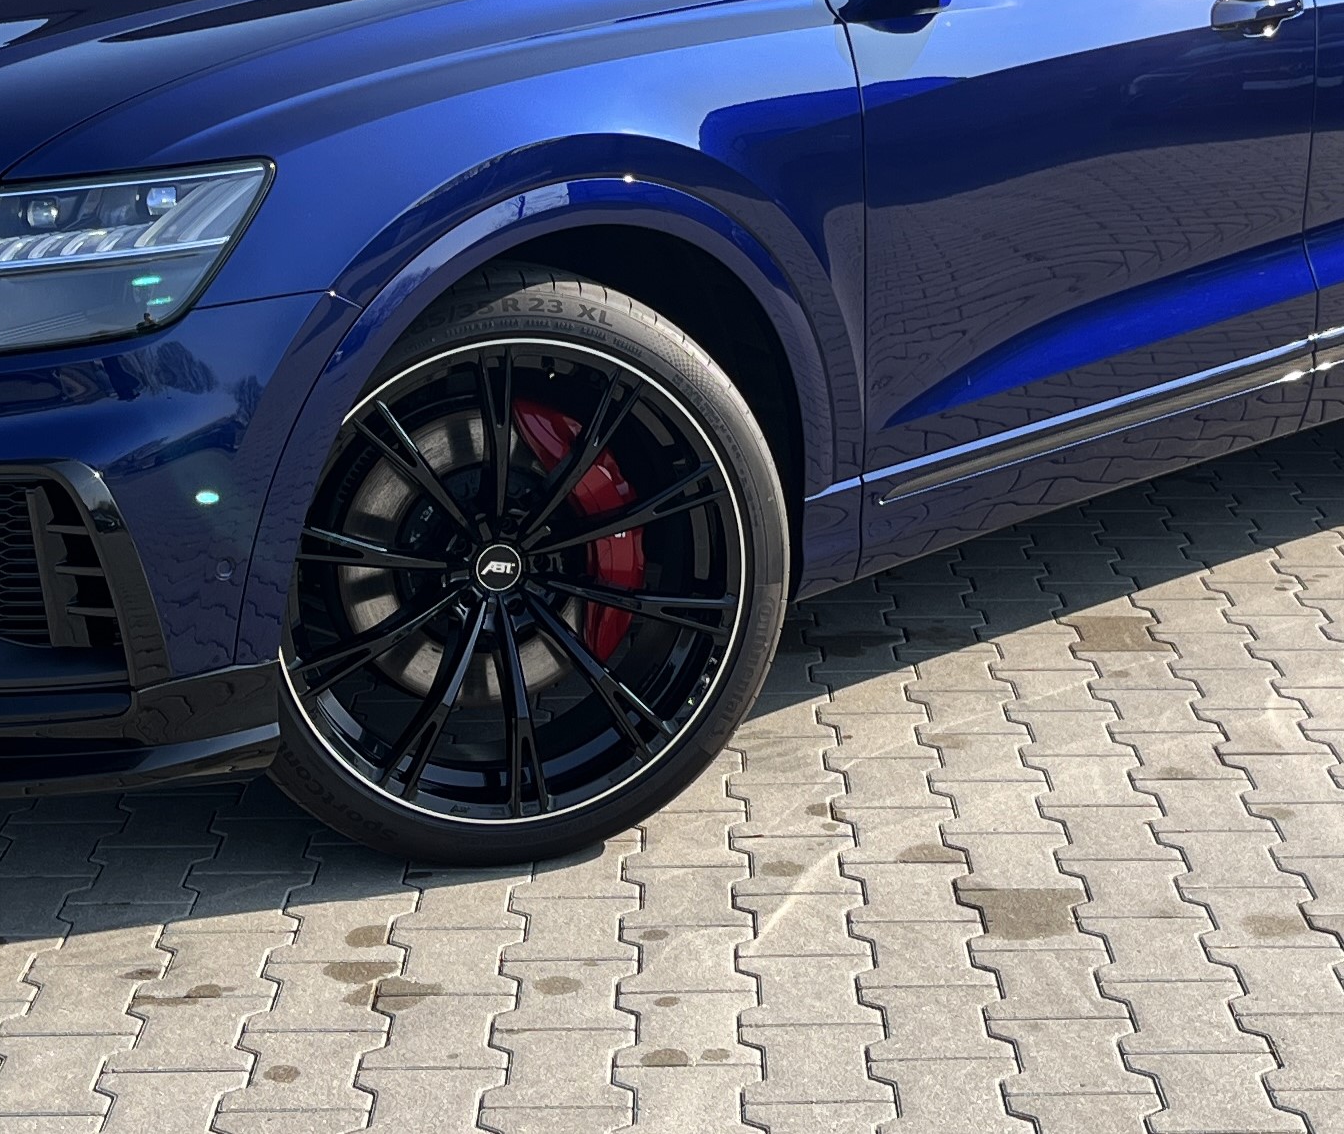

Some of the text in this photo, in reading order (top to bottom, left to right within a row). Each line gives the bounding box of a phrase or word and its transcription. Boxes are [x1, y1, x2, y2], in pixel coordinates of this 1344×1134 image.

[528, 297, 563, 314] 23
[577, 304, 613, 328] XL
[480, 560, 516, 575] ABT
